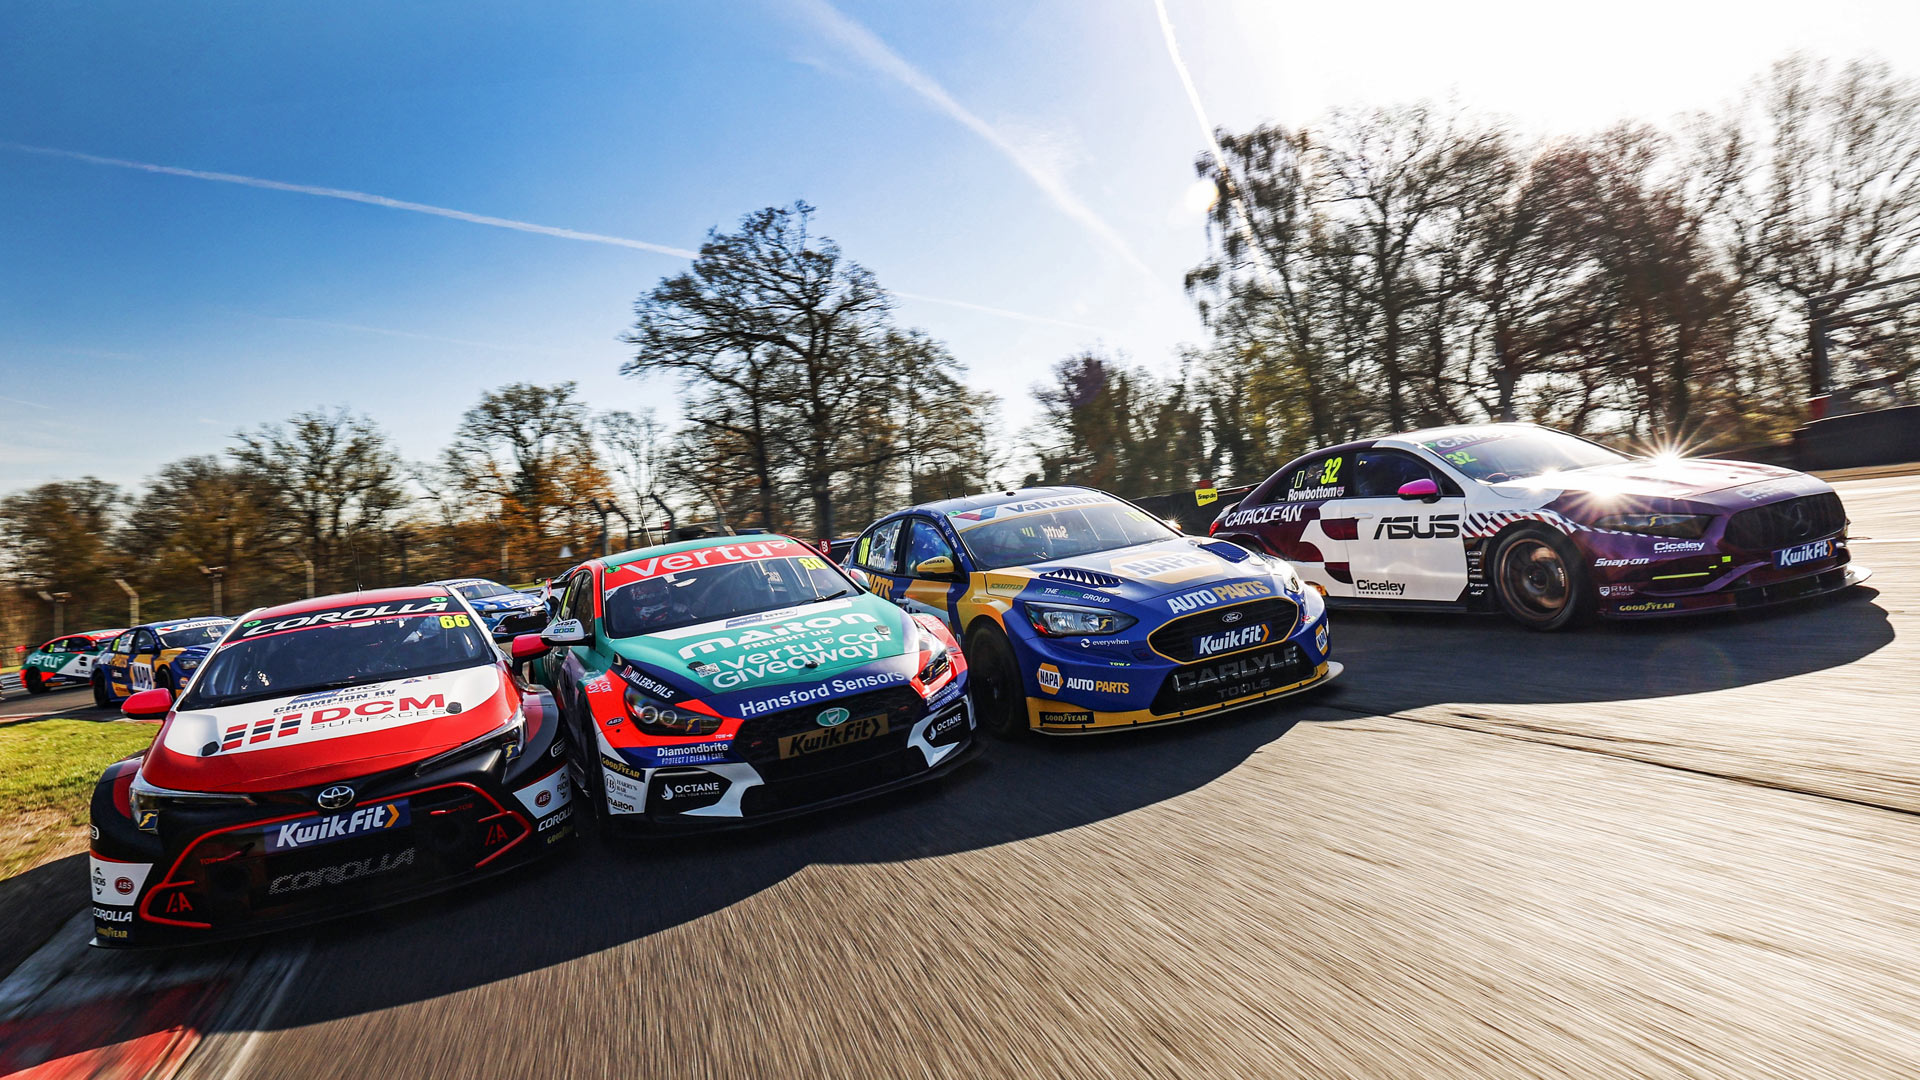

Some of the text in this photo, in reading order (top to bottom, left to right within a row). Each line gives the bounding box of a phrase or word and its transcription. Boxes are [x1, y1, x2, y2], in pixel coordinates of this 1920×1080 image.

[1445, 451, 1478, 465] 32
[1320, 457, 1343, 484] 32
[1287, 486, 1336, 501] Rowbottom
[1224, 505, 1305, 527] CATACLEAN
[1373, 514, 1459, 540] ASUS
[1653, 541, 1705, 551] Ciceley
[622, 541, 774, 578] vertu
[798, 556, 828, 570] 80
[1121, 554, 1210, 576] NAPA
[1594, 558, 1649, 567] Snap-on
[1356, 580, 1405, 595] Ciceley
[1082, 593, 1110, 604] GROUP
[1167, 581, 1271, 615] AUTO PARTS
[1619, 602, 1676, 612] GOODYEAR
[243, 602, 448, 637] COROLLA
[439, 614, 470, 629] 66
[743, 627, 833, 651] FREIGHT UK
[1093, 639, 1129, 647] everywhen
[1172, 645, 1300, 693] CARLYLE
[630, 669, 655, 690] MILLERS
[652, 683, 675, 699] OILS
[1040, 669, 1060, 688] NAPA
[1066, 677, 1130, 694] AUTO PARTS
[1218, 677, 1271, 698] TOOLS
[273, 693, 368, 713] CHAMPION
[375, 689, 396, 697] RV
[738, 669, 904, 717] Hansford Sensors
[310, 693, 445, 725] DCM
[1045, 713, 1088, 723] GOODYEAR
[310, 708, 446, 731] SURFACES
[937, 713, 962, 731] OCTANE
[656, 742, 729, 757] Diamondbrite
[602, 757, 641, 779] GOODYEAR
[674, 782, 720, 794] OCTANE
[538, 794, 551, 803] ABS
[268, 848, 416, 894] COROLLA
[118, 881, 132, 890] ABS
[92, 907, 133, 923] COROLLA
